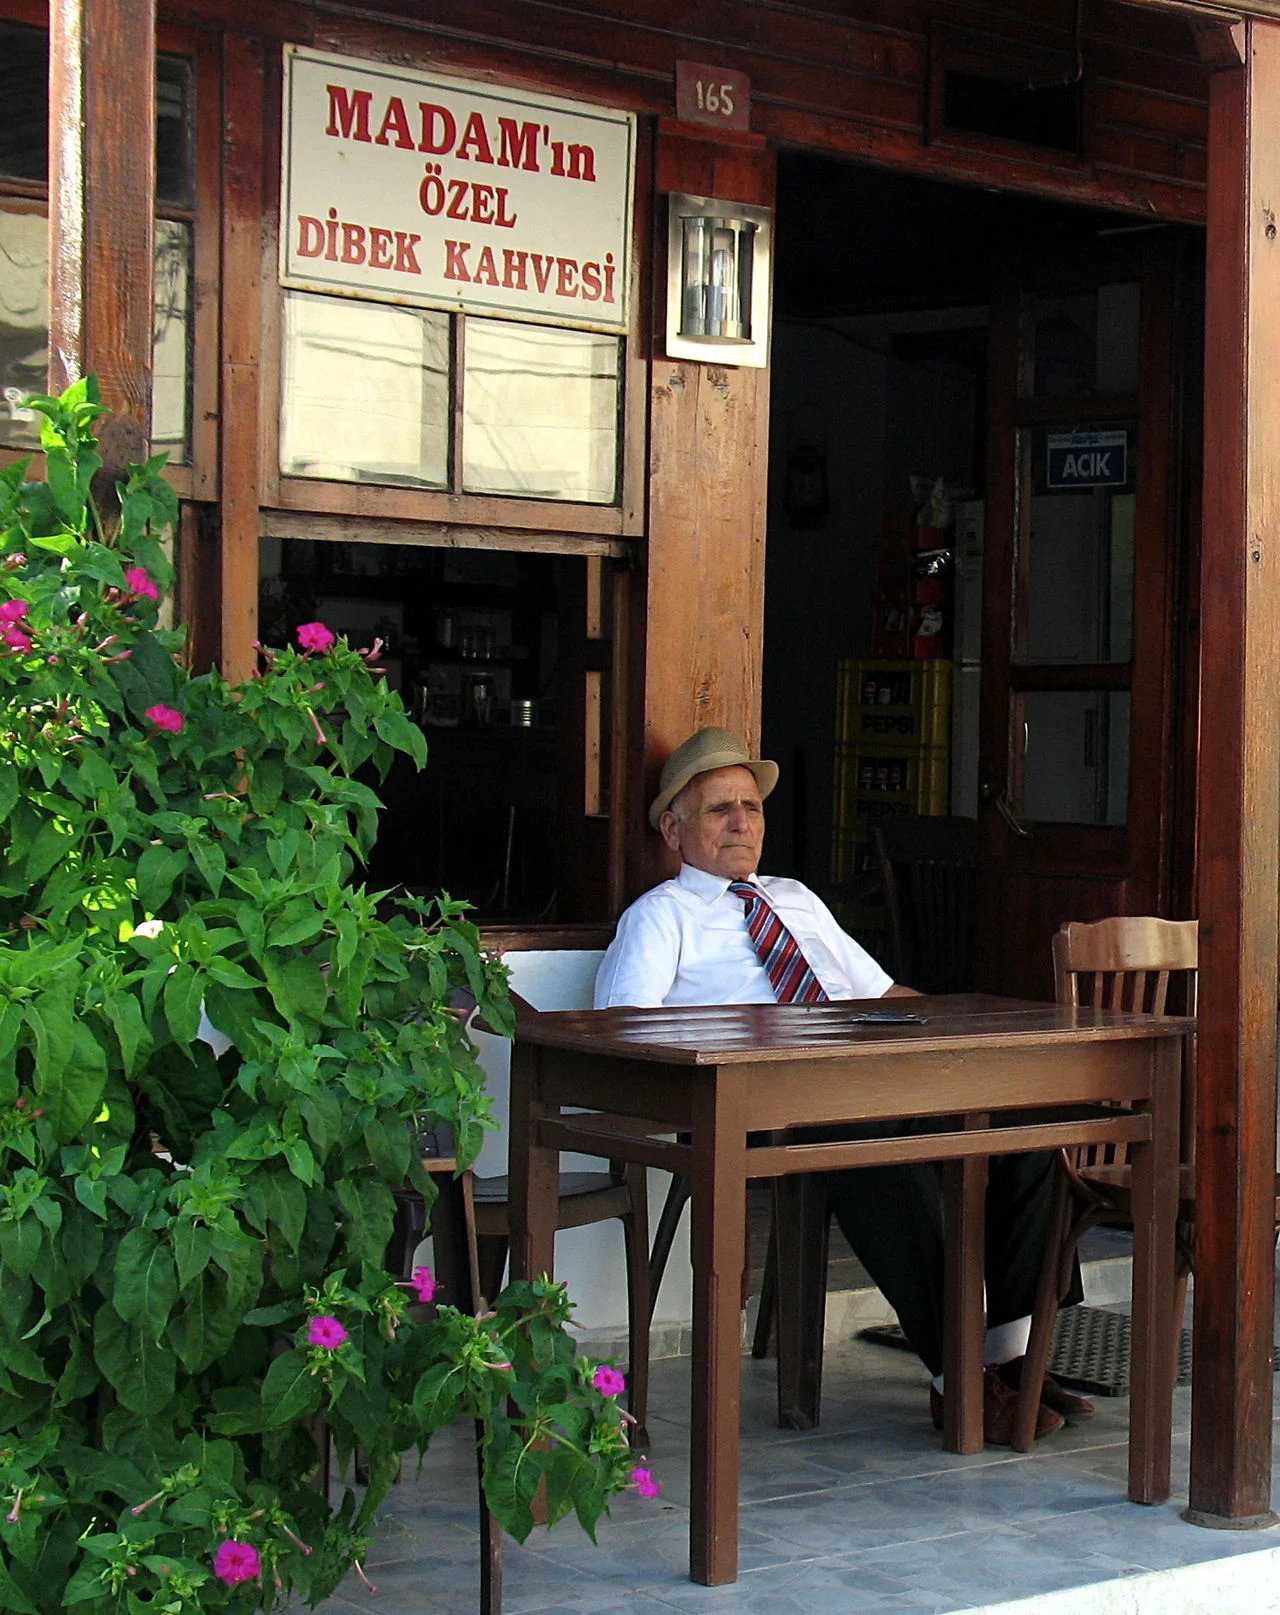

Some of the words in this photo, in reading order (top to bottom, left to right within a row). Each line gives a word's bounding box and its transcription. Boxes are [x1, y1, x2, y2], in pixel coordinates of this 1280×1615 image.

[696, 80, 734, 115] 165
[325, 84, 597, 182] MADAM'ın
[418, 161, 519, 229] ÖZEL
[296, 207, 423, 275] DİBEK
[443, 239, 617, 304] KAHVESİ
[861, 715, 914, 735] PEPSI
